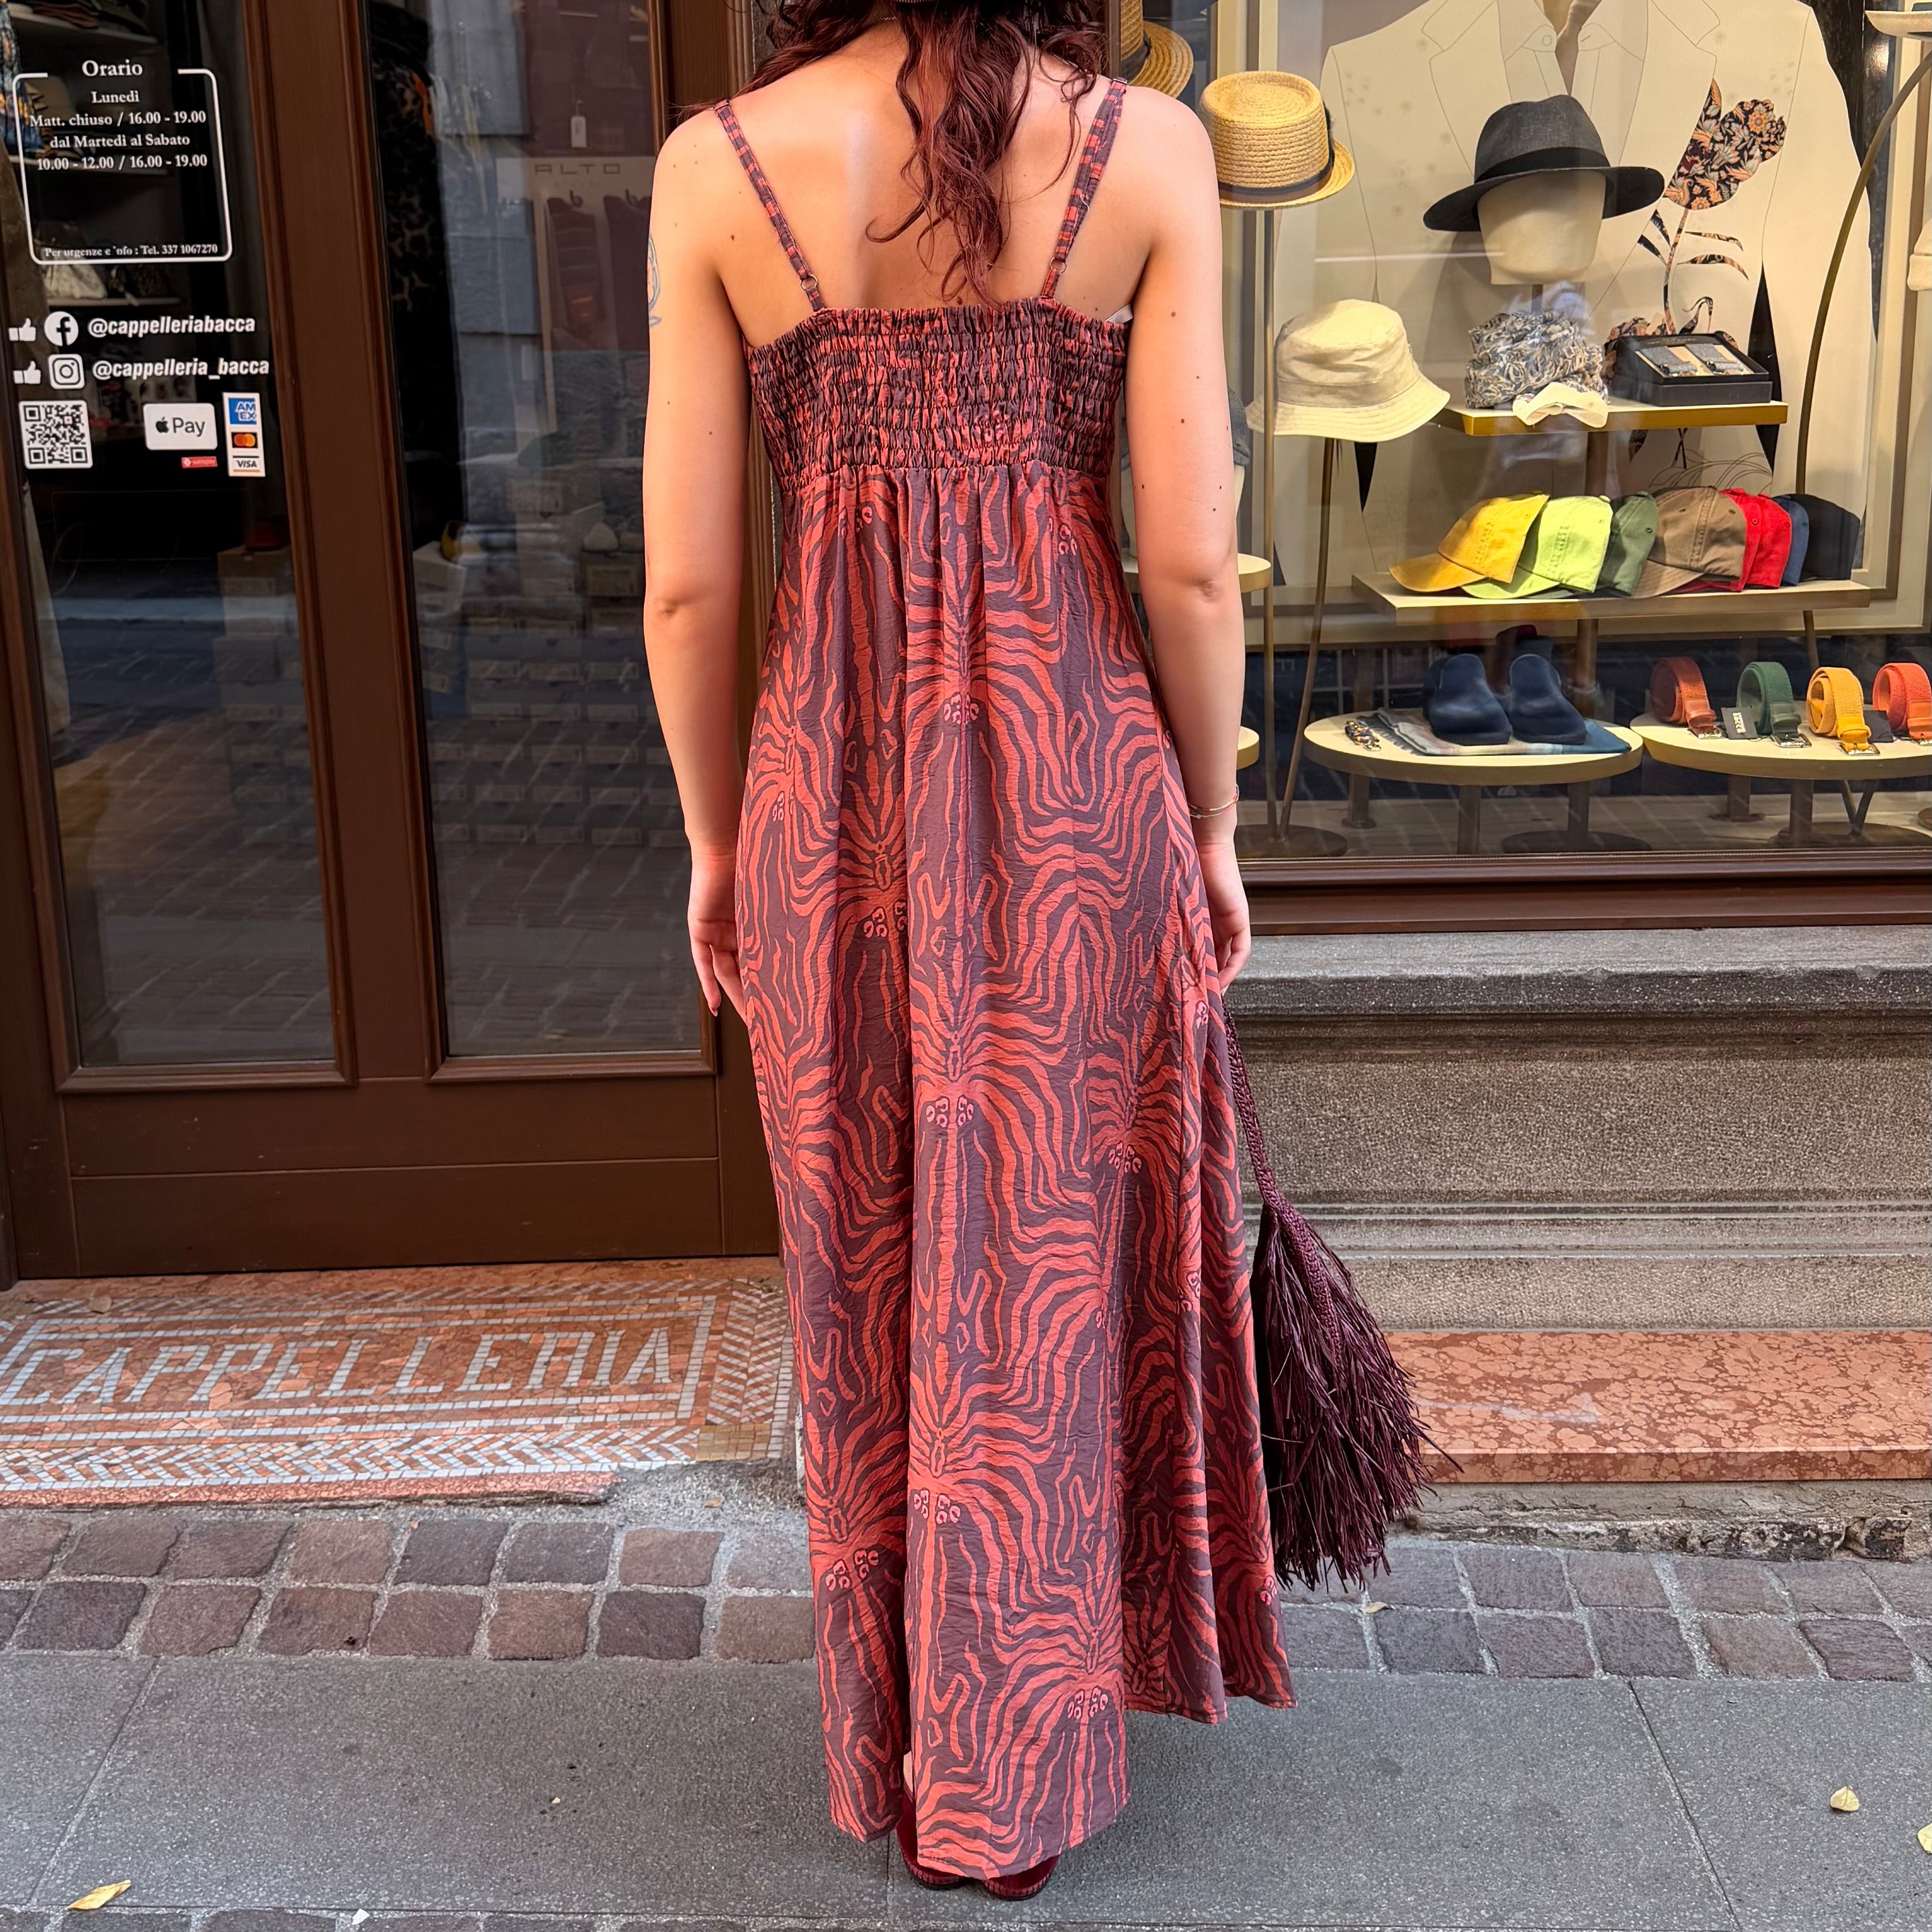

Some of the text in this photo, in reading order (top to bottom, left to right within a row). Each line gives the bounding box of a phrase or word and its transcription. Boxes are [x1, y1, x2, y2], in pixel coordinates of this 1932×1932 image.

[82, 59, 143, 77] Orario
[91, 90, 140, 104] Lunedì
[29, 115, 66, 127] Matt.
[69, 114, 112, 126] chiuso
[128, 112, 161, 124] 16.00
[173, 110, 206, 124] 19.00
[50, 134, 190, 149] dal Martedì al Sabato
[37, 158, 69, 171] 10.00
[81, 156, 114, 170] 12.00
[130, 156, 162, 169] 16.00
[175, 155, 207, 167] 19.00
[534, 163, 621, 175] ALTO
[45, 247, 61, 257] Per
[64, 248, 102, 259] urgenze
[140, 245, 160, 256] Tel.
[161, 245, 178, 254] 337
[180, 244, 218, 254] 1067270
[88, 315, 256, 339] @cappelleriabacca
[92, 357, 270, 381] @cappelleria_bacca
[172, 417, 206, 437] Pay
[236, 460, 257, 468] VISA
[0, 1326, 672, 1405] CAPPELLERIA
